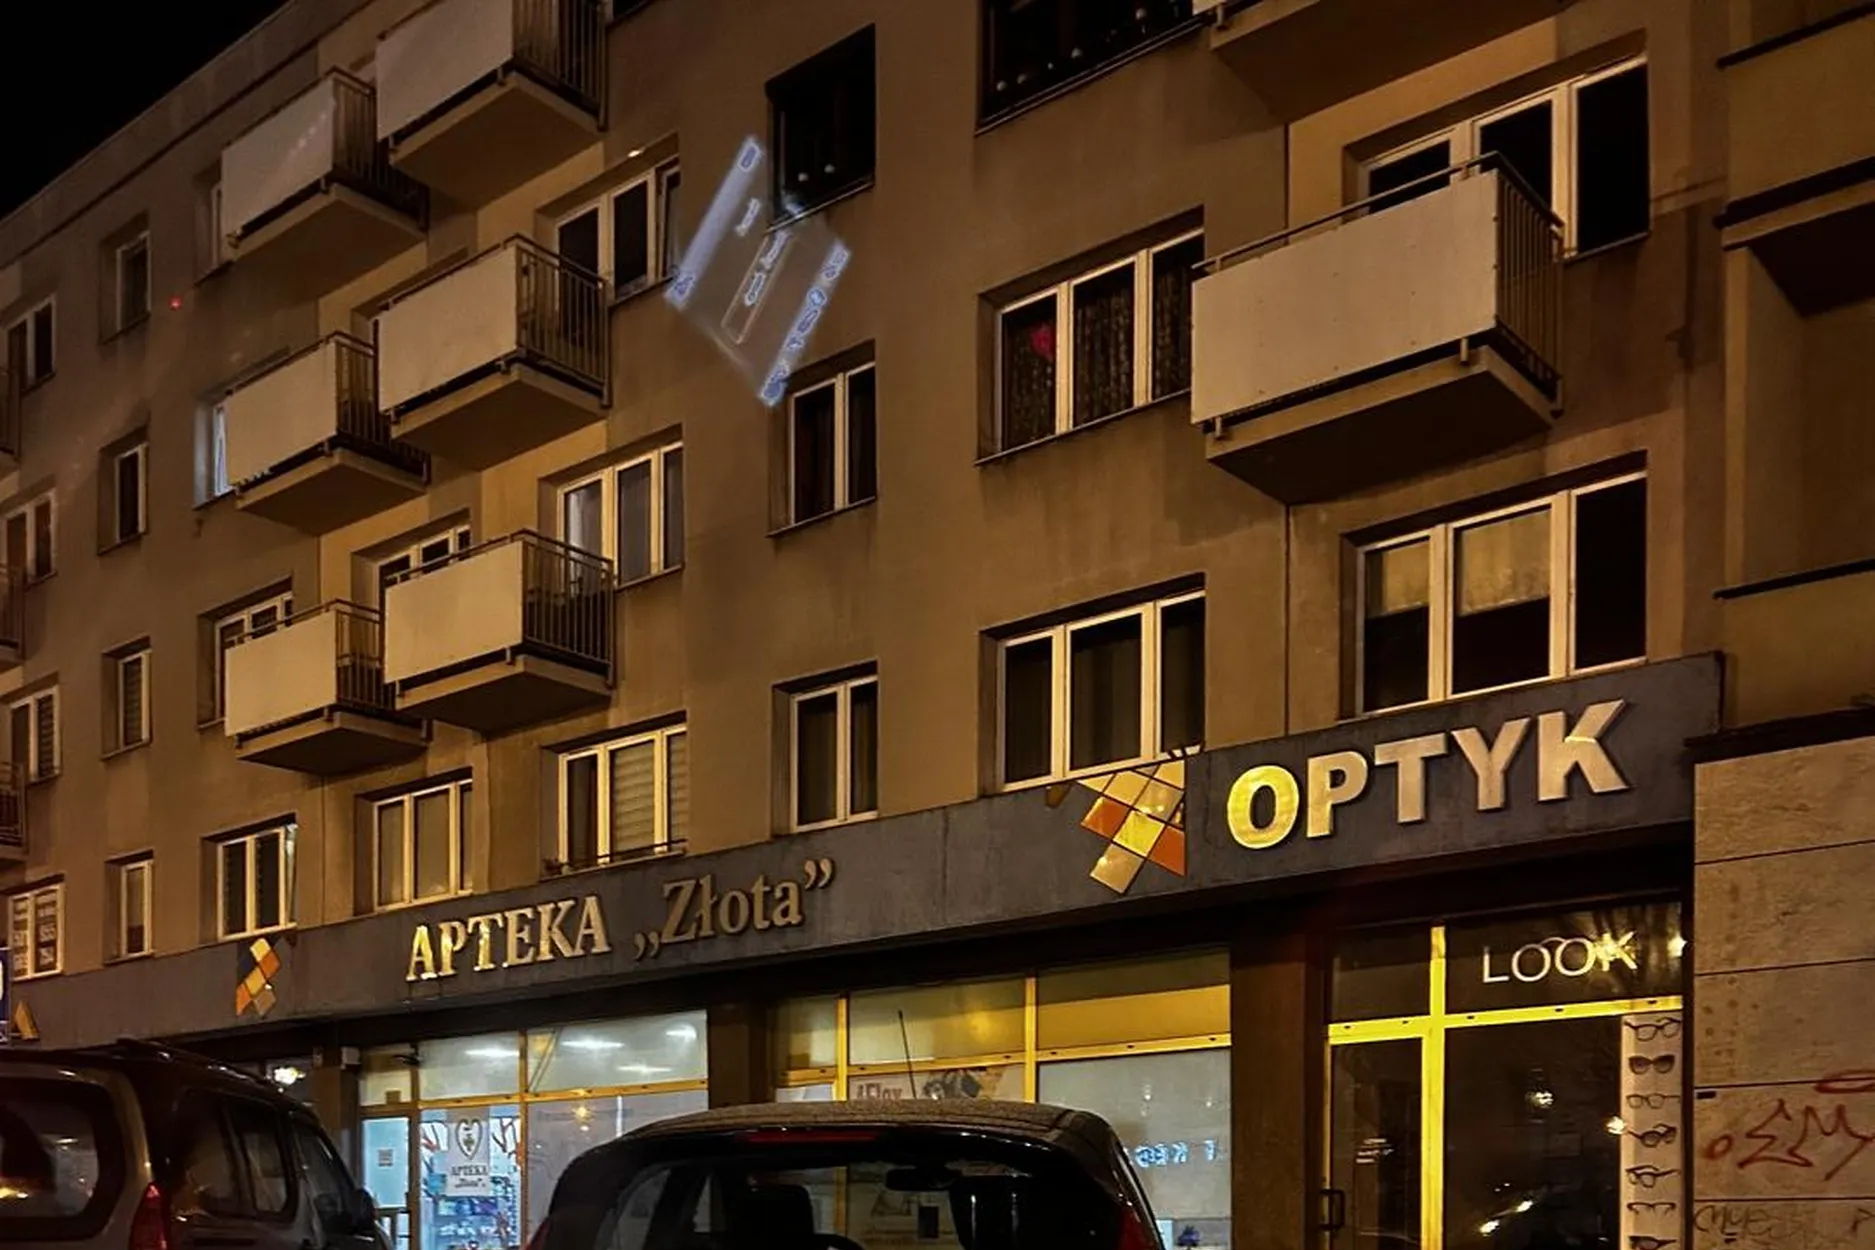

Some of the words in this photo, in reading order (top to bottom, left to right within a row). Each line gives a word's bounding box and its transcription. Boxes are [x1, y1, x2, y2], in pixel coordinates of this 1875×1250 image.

[1227, 699, 1632, 849] OPTYK
[406, 894, 612, 982] APTEKA
[1482, 930, 1639, 984] LOOK
